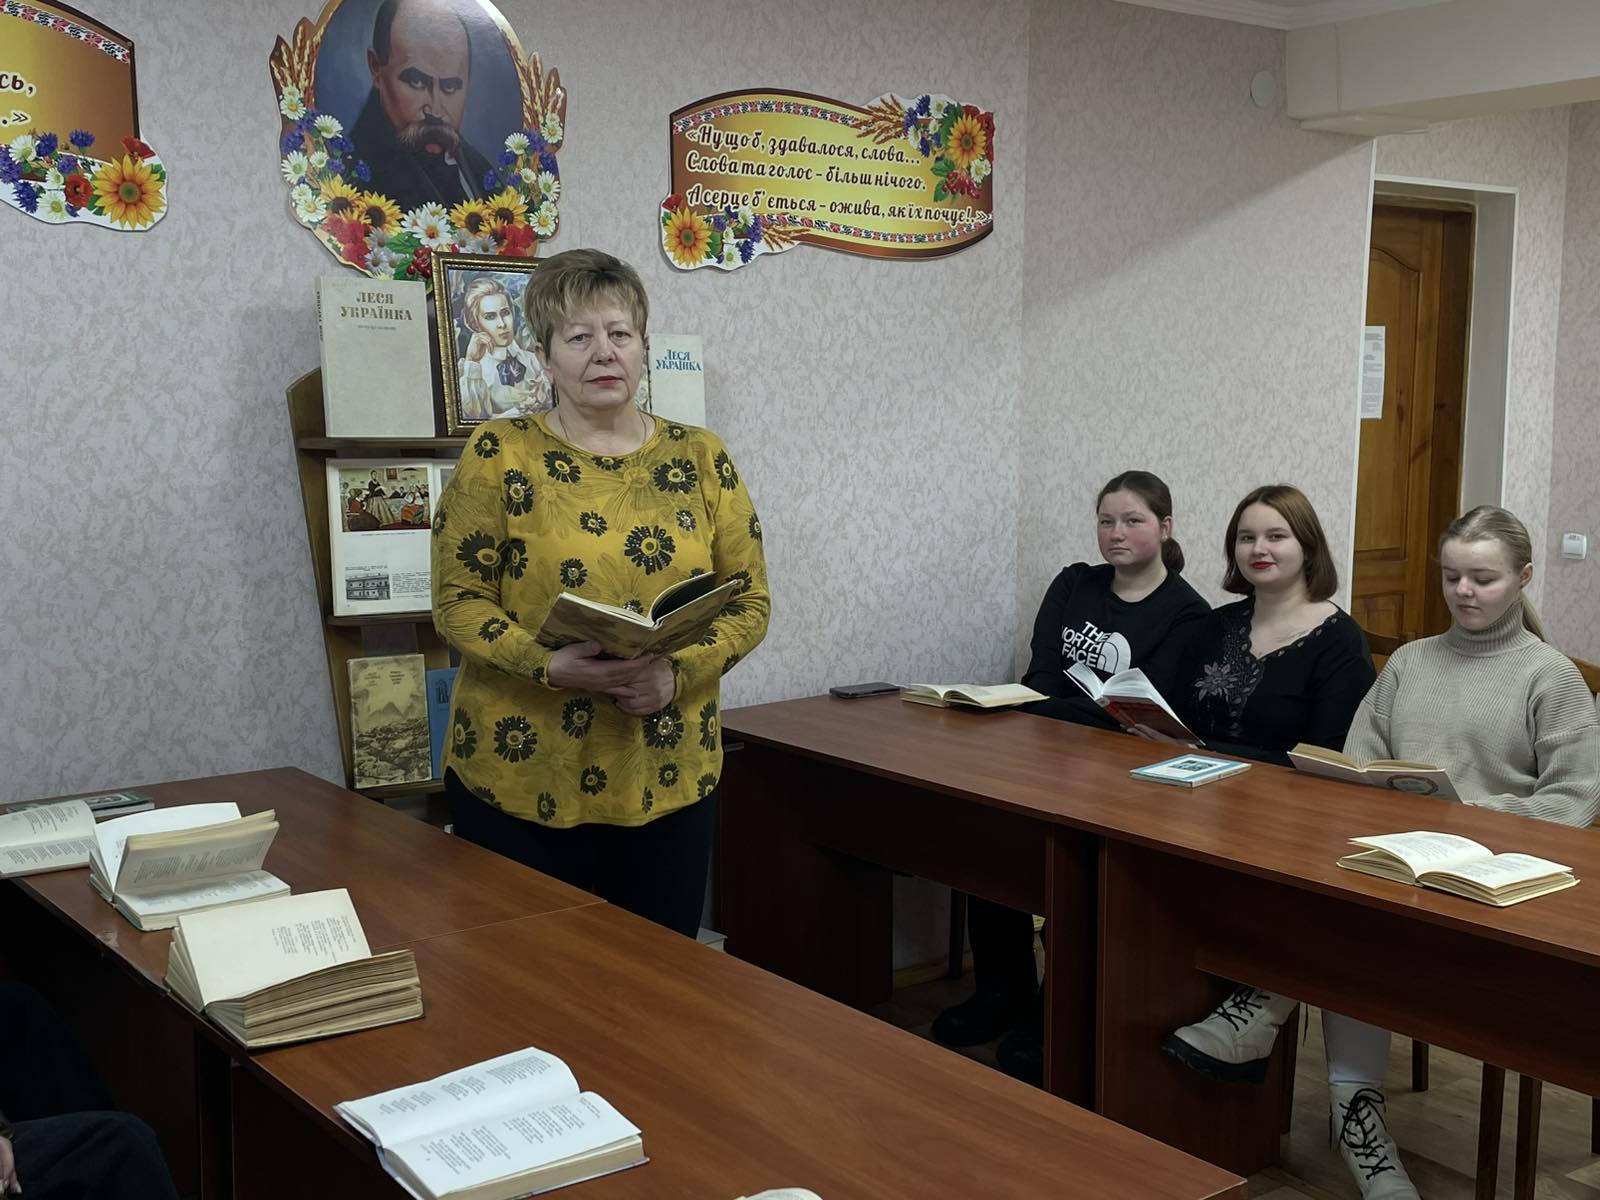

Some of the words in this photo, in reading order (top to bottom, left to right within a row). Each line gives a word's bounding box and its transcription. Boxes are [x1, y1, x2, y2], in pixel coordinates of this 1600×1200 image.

[724, 132, 749, 150] що
[751, 131, 765, 150] б,
[768, 136, 859, 160] здавалося,
[861, 146, 920, 164] слова...
[687, 151, 738, 172] Слова
[741, 161, 765, 177] та
[768, 165, 813, 180] голос
[825, 166, 872, 186] більш
[874, 171, 926, 190] нічого.
[687, 184, 701, 204] А
[702, 190, 749, 209] серце
[829, 199, 886, 218] ожива,
[887, 207, 906, 219] як
[907, 203, 922, 220] їх
[356, 291, 395, 305] ЛЕСЯ
[340, 305, 413, 321] УКРАЇНКА
[1081, 620, 1112, 643] THE
[1061, 642, 1098, 668] FACE
